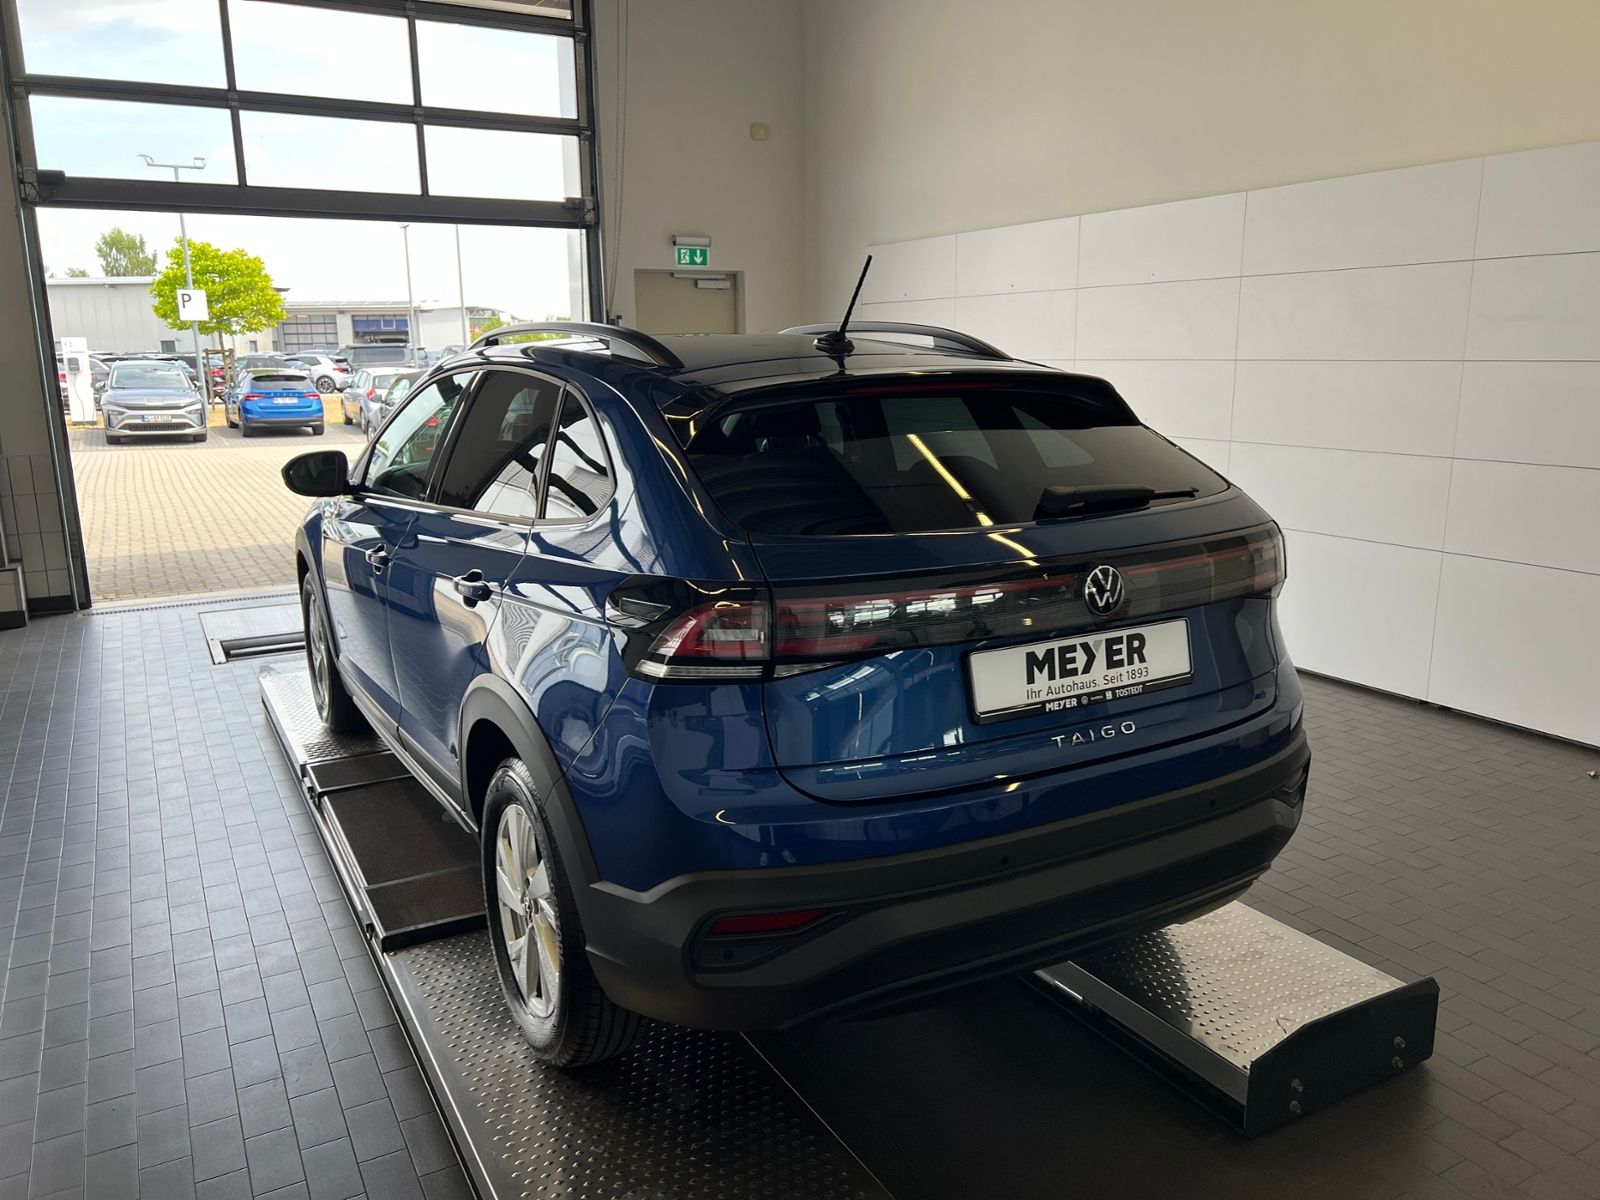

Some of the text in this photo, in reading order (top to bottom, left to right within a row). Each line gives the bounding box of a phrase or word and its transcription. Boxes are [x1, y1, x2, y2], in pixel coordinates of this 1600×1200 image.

[181, 293, 192, 309] P
[1025, 632, 1147, 685] MEYER
[1026, 666, 1149, 700] Ihr Autohaus. Seit 1893
[1045, 684, 1143, 712] MEYER TOSTEDT
[1051, 721, 1136, 749] TAIGO
